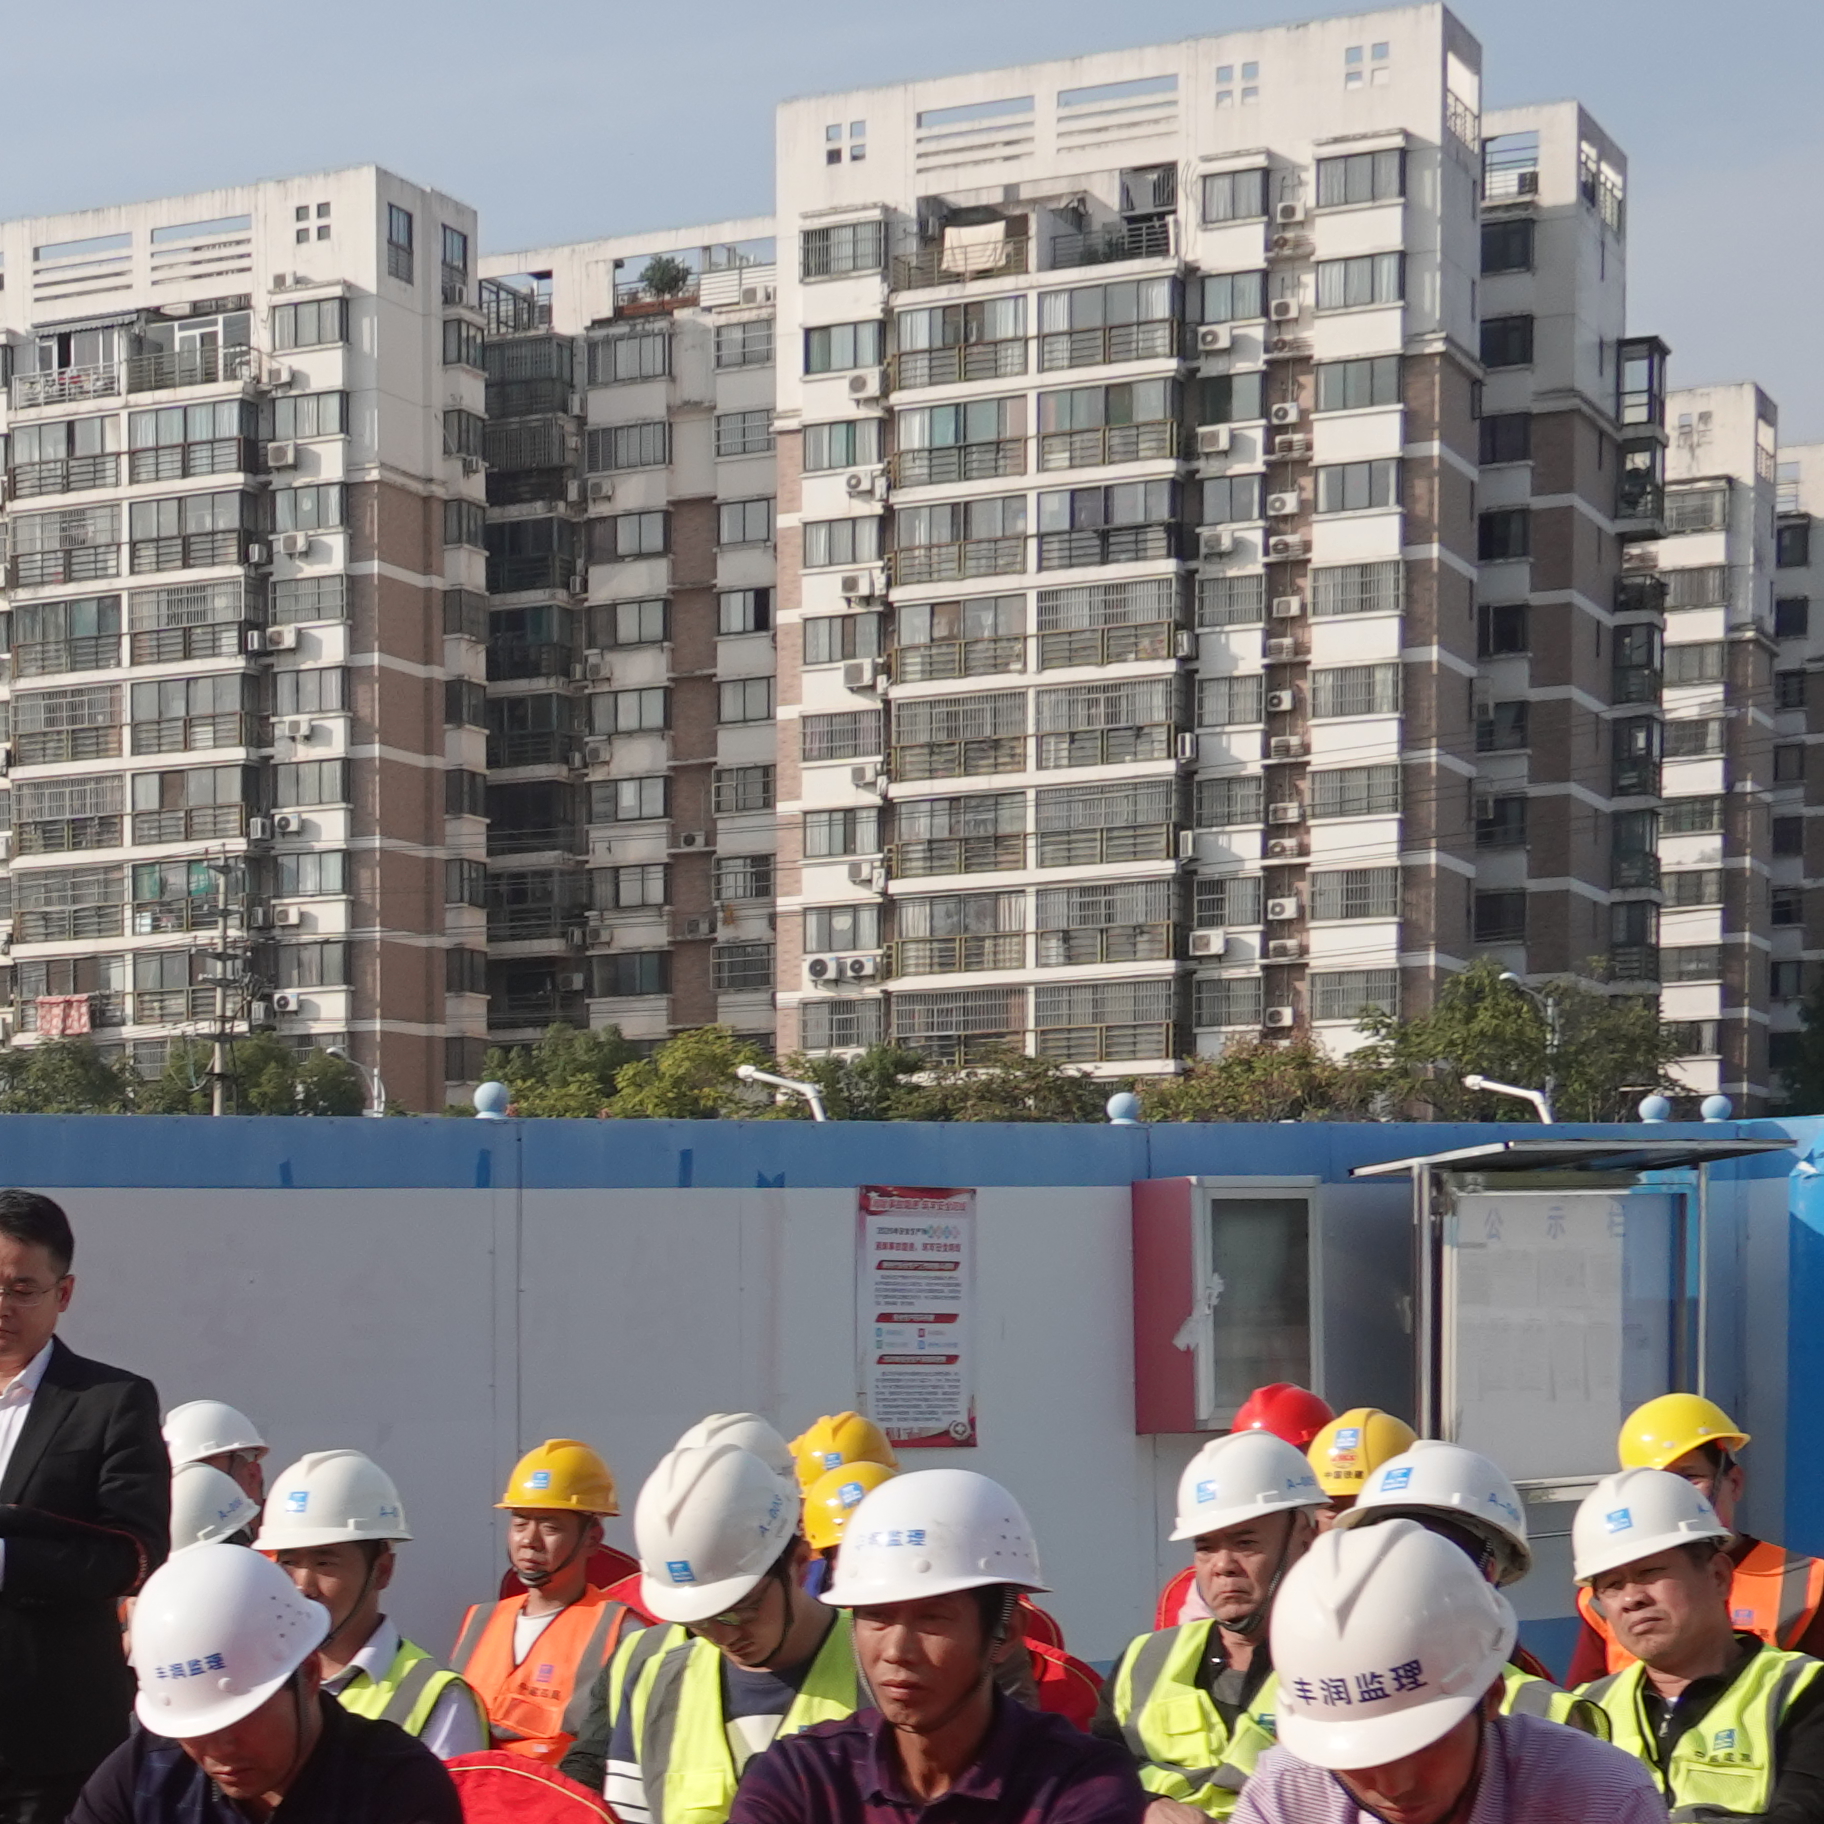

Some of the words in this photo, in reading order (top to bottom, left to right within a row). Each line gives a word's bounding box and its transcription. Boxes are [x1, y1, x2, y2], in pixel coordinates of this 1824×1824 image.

[1323, 1469, 1364, 1480] 中国铁建
[1293, 1659, 1429, 1706] 丰润监理
